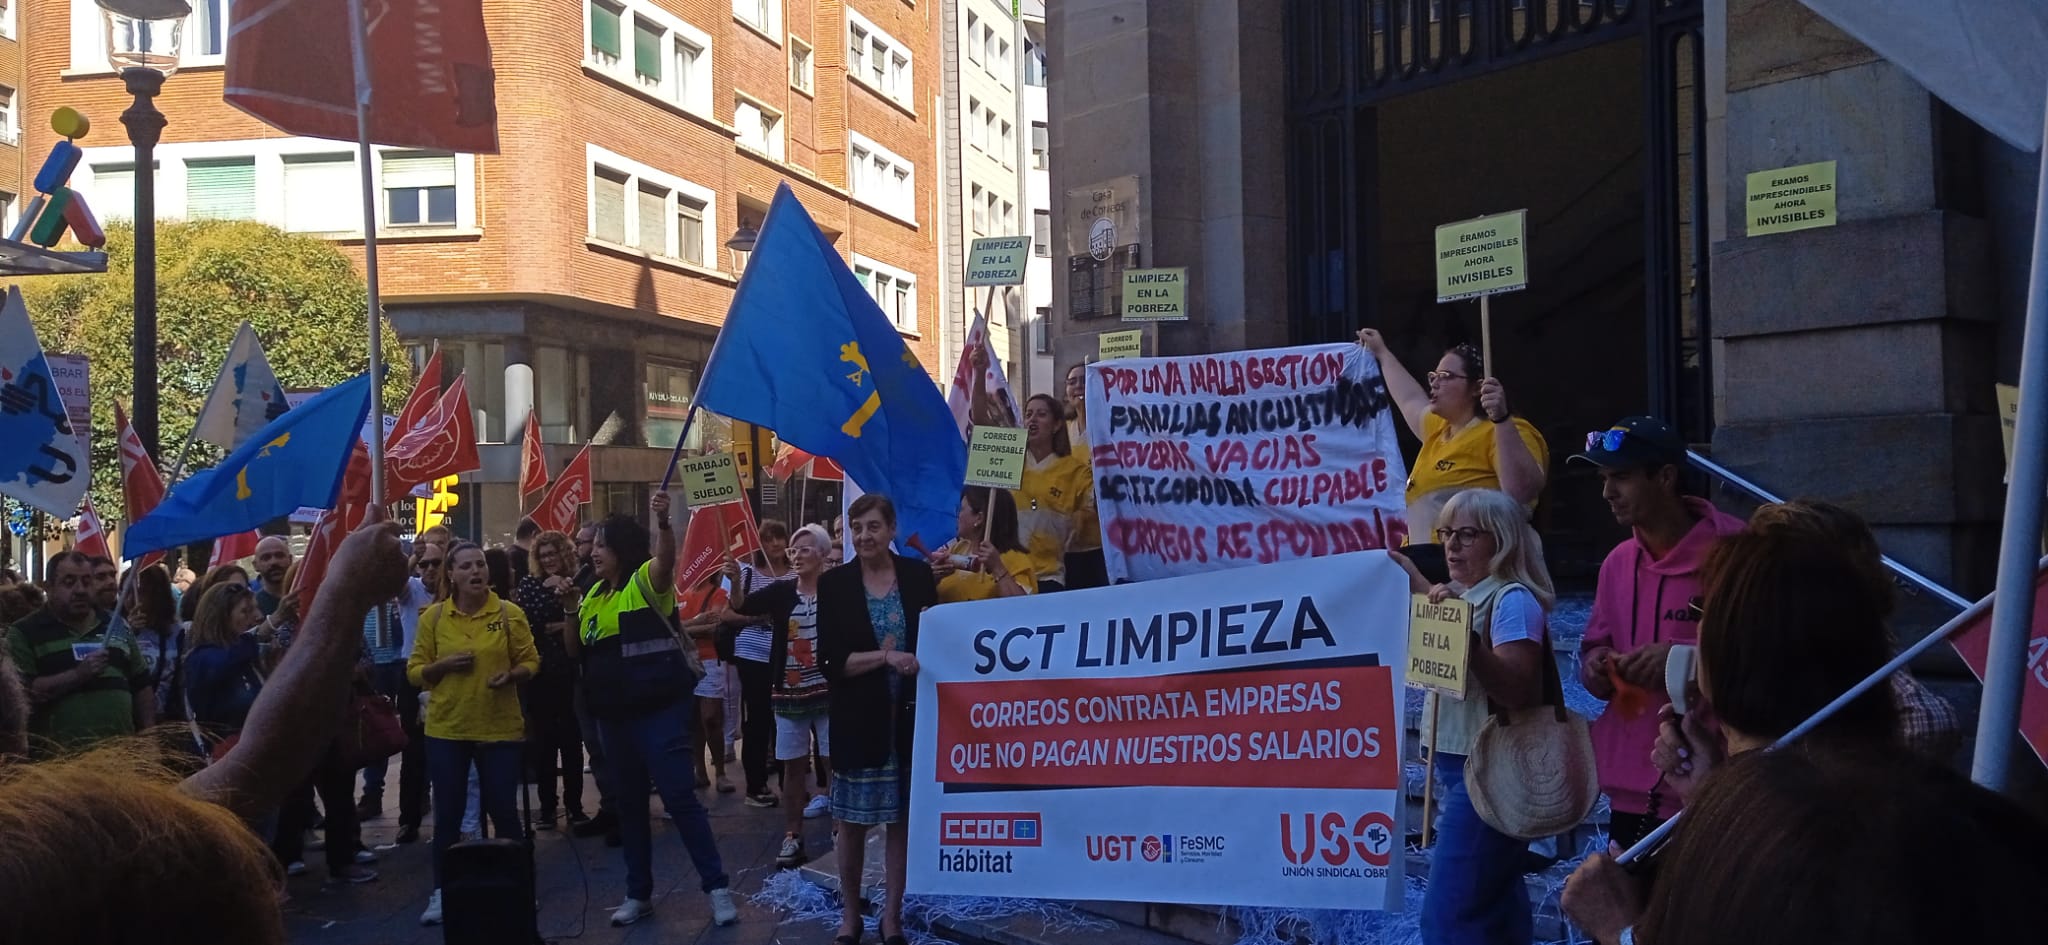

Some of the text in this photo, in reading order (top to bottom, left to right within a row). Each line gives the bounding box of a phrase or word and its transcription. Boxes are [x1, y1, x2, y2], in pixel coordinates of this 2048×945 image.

[1750, 184, 1832, 201] IMPRESCINDIBLES
[1774, 199, 1806, 209] AHORA
[1757, 209, 1825, 226] INVISIBLES
[976, 241, 1023, 250] LIMPIEZA
[1440, 237, 1519, 259] IMPRESCINDIBLES
[982, 256, 996, 264] EN
[1464, 256, 1494, 267] AHORA
[971, 269, 1017, 279] POBREZA
[1128, 274, 1179, 283] LIMPIEZA
[1448, 266, 1513, 286] INVISIBLES
[1137, 289, 1169, 297] EN LA
[1127, 304, 1179, 312] POBREZA
[1107, 335, 1133, 343] CORREOS
[1101, 344, 1140, 353] RESPONSABLE
[1099, 352, 1344, 402] POR UNA MALA GESTION
[1110, 402, 1222, 437] FAMILIAS
[983, 432, 1017, 441] CORREOS
[972, 443, 1024, 455] RESPONSABLE
[1205, 434, 1321, 473] VACIAS
[684, 458, 731, 473] TRABAJO
[990, 458, 1004, 466] SCT
[1436, 460, 1456, 471] SCT
[976, 469, 1013, 480] CULPABLE
[1264, 458, 1387, 508] CULPABLE
[693, 485, 734, 500] SUELDO
[682, 545, 713, 581] ASTURIAS
[1415, 603, 1462, 623] LIMPIEZA
[487, 621, 503, 632] SCT
[973, 595, 1337, 675] SCT LIMPIEZA
[1422, 631, 1450, 651] EN LA
[1411, 657, 1458, 681] POBREZA
[970, 680, 1341, 729] CORREOS CONTRATA EMPRESAS
[950, 727, 1380, 774] QUE NO PAGAN NUESTROS SALARIOS
[945, 819, 1009, 839] CCOO
[1180, 835, 1225, 850] FeSMC
[1280, 811, 1394, 867] USO
[1086, 835, 1137, 862] UGT
[939, 847, 1013, 873] hábitat
[1282, 866, 1314, 877] UNIÓN
[1316, 867, 1361, 877] SINDICAL
